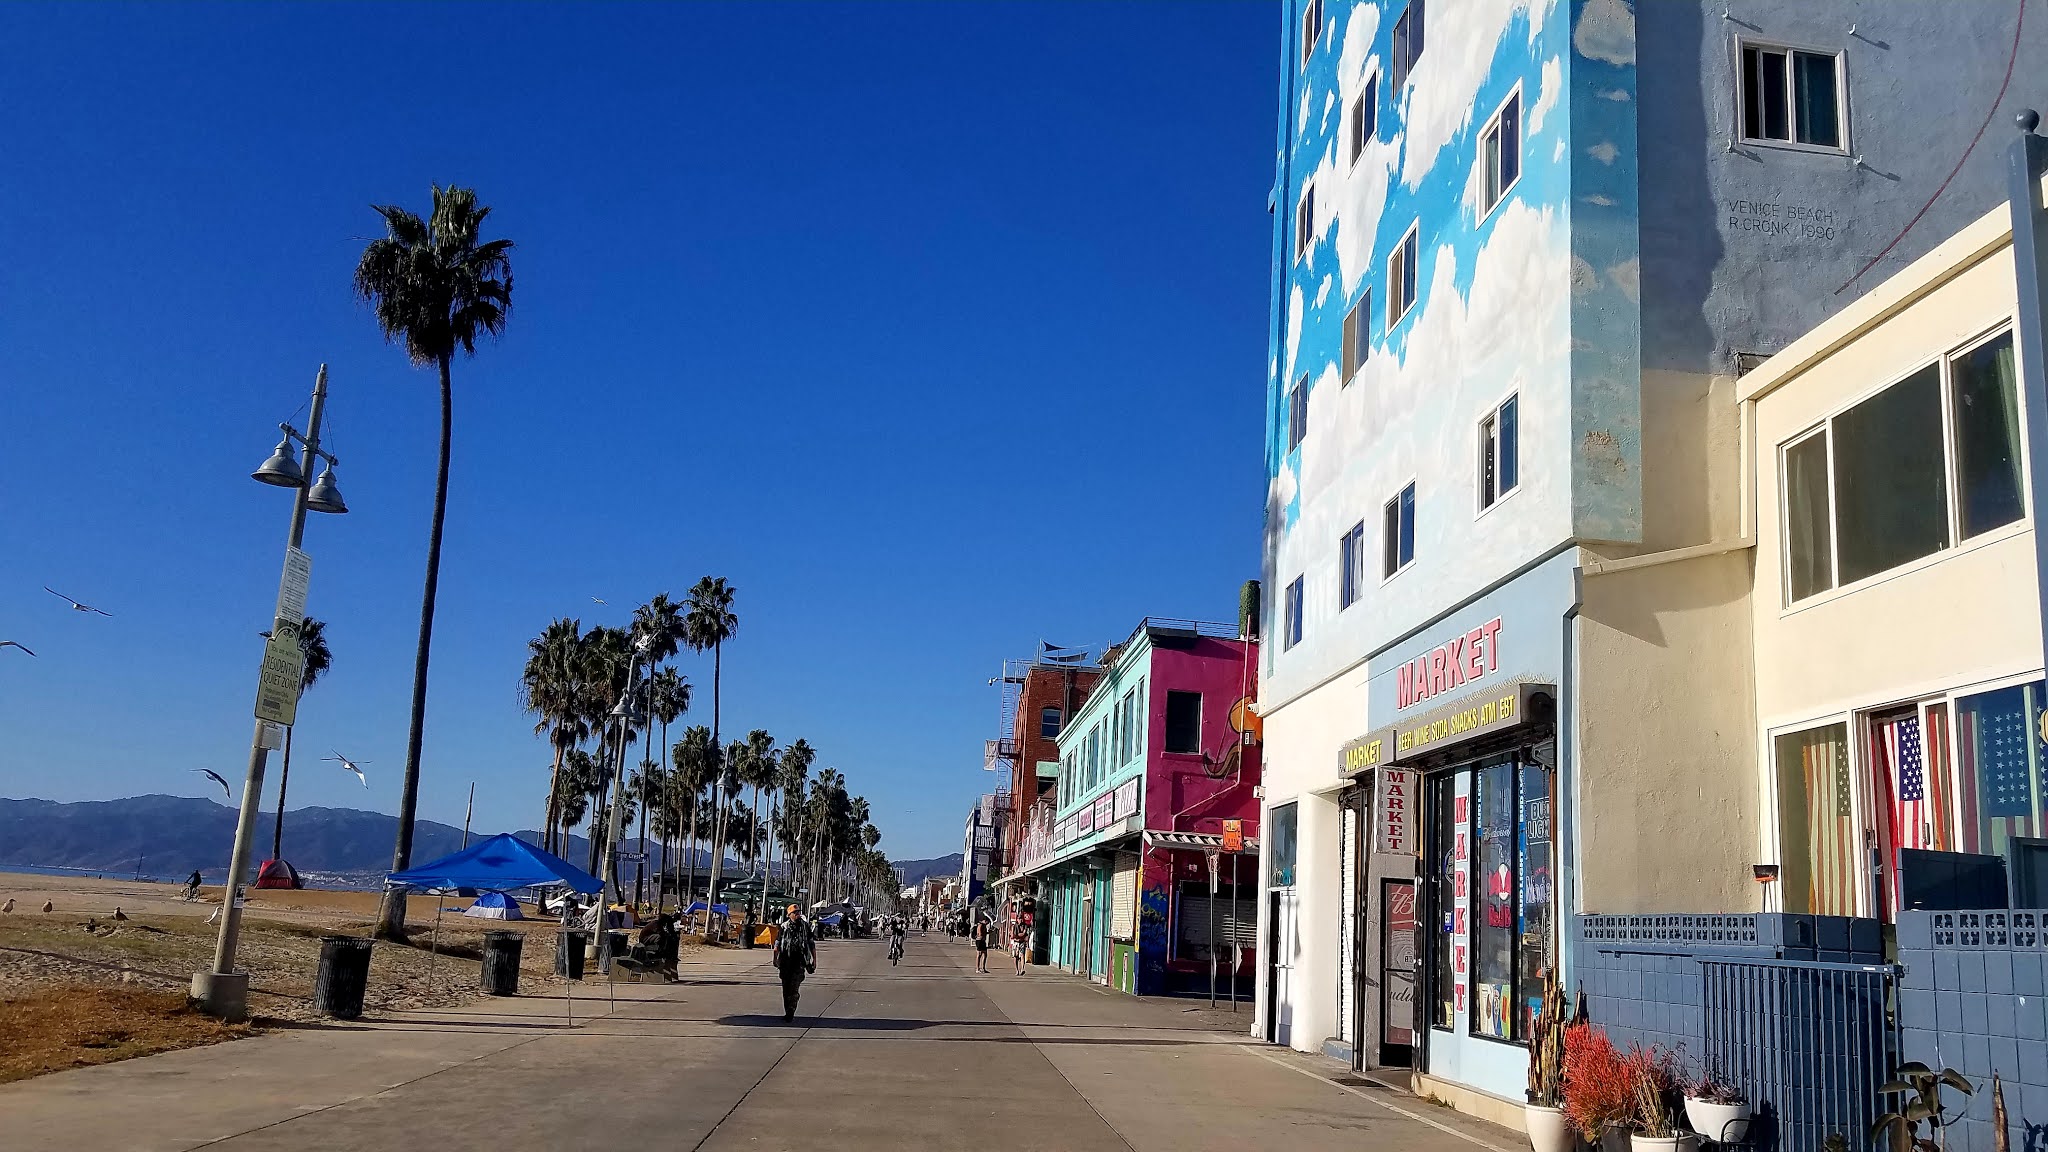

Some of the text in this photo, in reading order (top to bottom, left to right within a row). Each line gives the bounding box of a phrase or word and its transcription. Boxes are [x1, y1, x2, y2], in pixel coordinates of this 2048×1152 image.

[1729, 200, 1834, 224] VENICE BEACH
[1801, 223, 1836, 241] 1990
[265, 655, 300, 678] RESIDENTIAL
[1396, 615, 1502, 712] MARKET
[263, 671, 282, 686] QUIET
[281, 677, 298, 692] ZONE
[1398, 694, 1516, 752] BEER WINE SODA SNACKS ATM EBT
[1346, 740, 1382, 772] MARKET
[1386, 770, 1406, 850] MARKET
[975, 836, 997, 849] FLOWER
[1455, 793, 1469, 1014] MARKET
